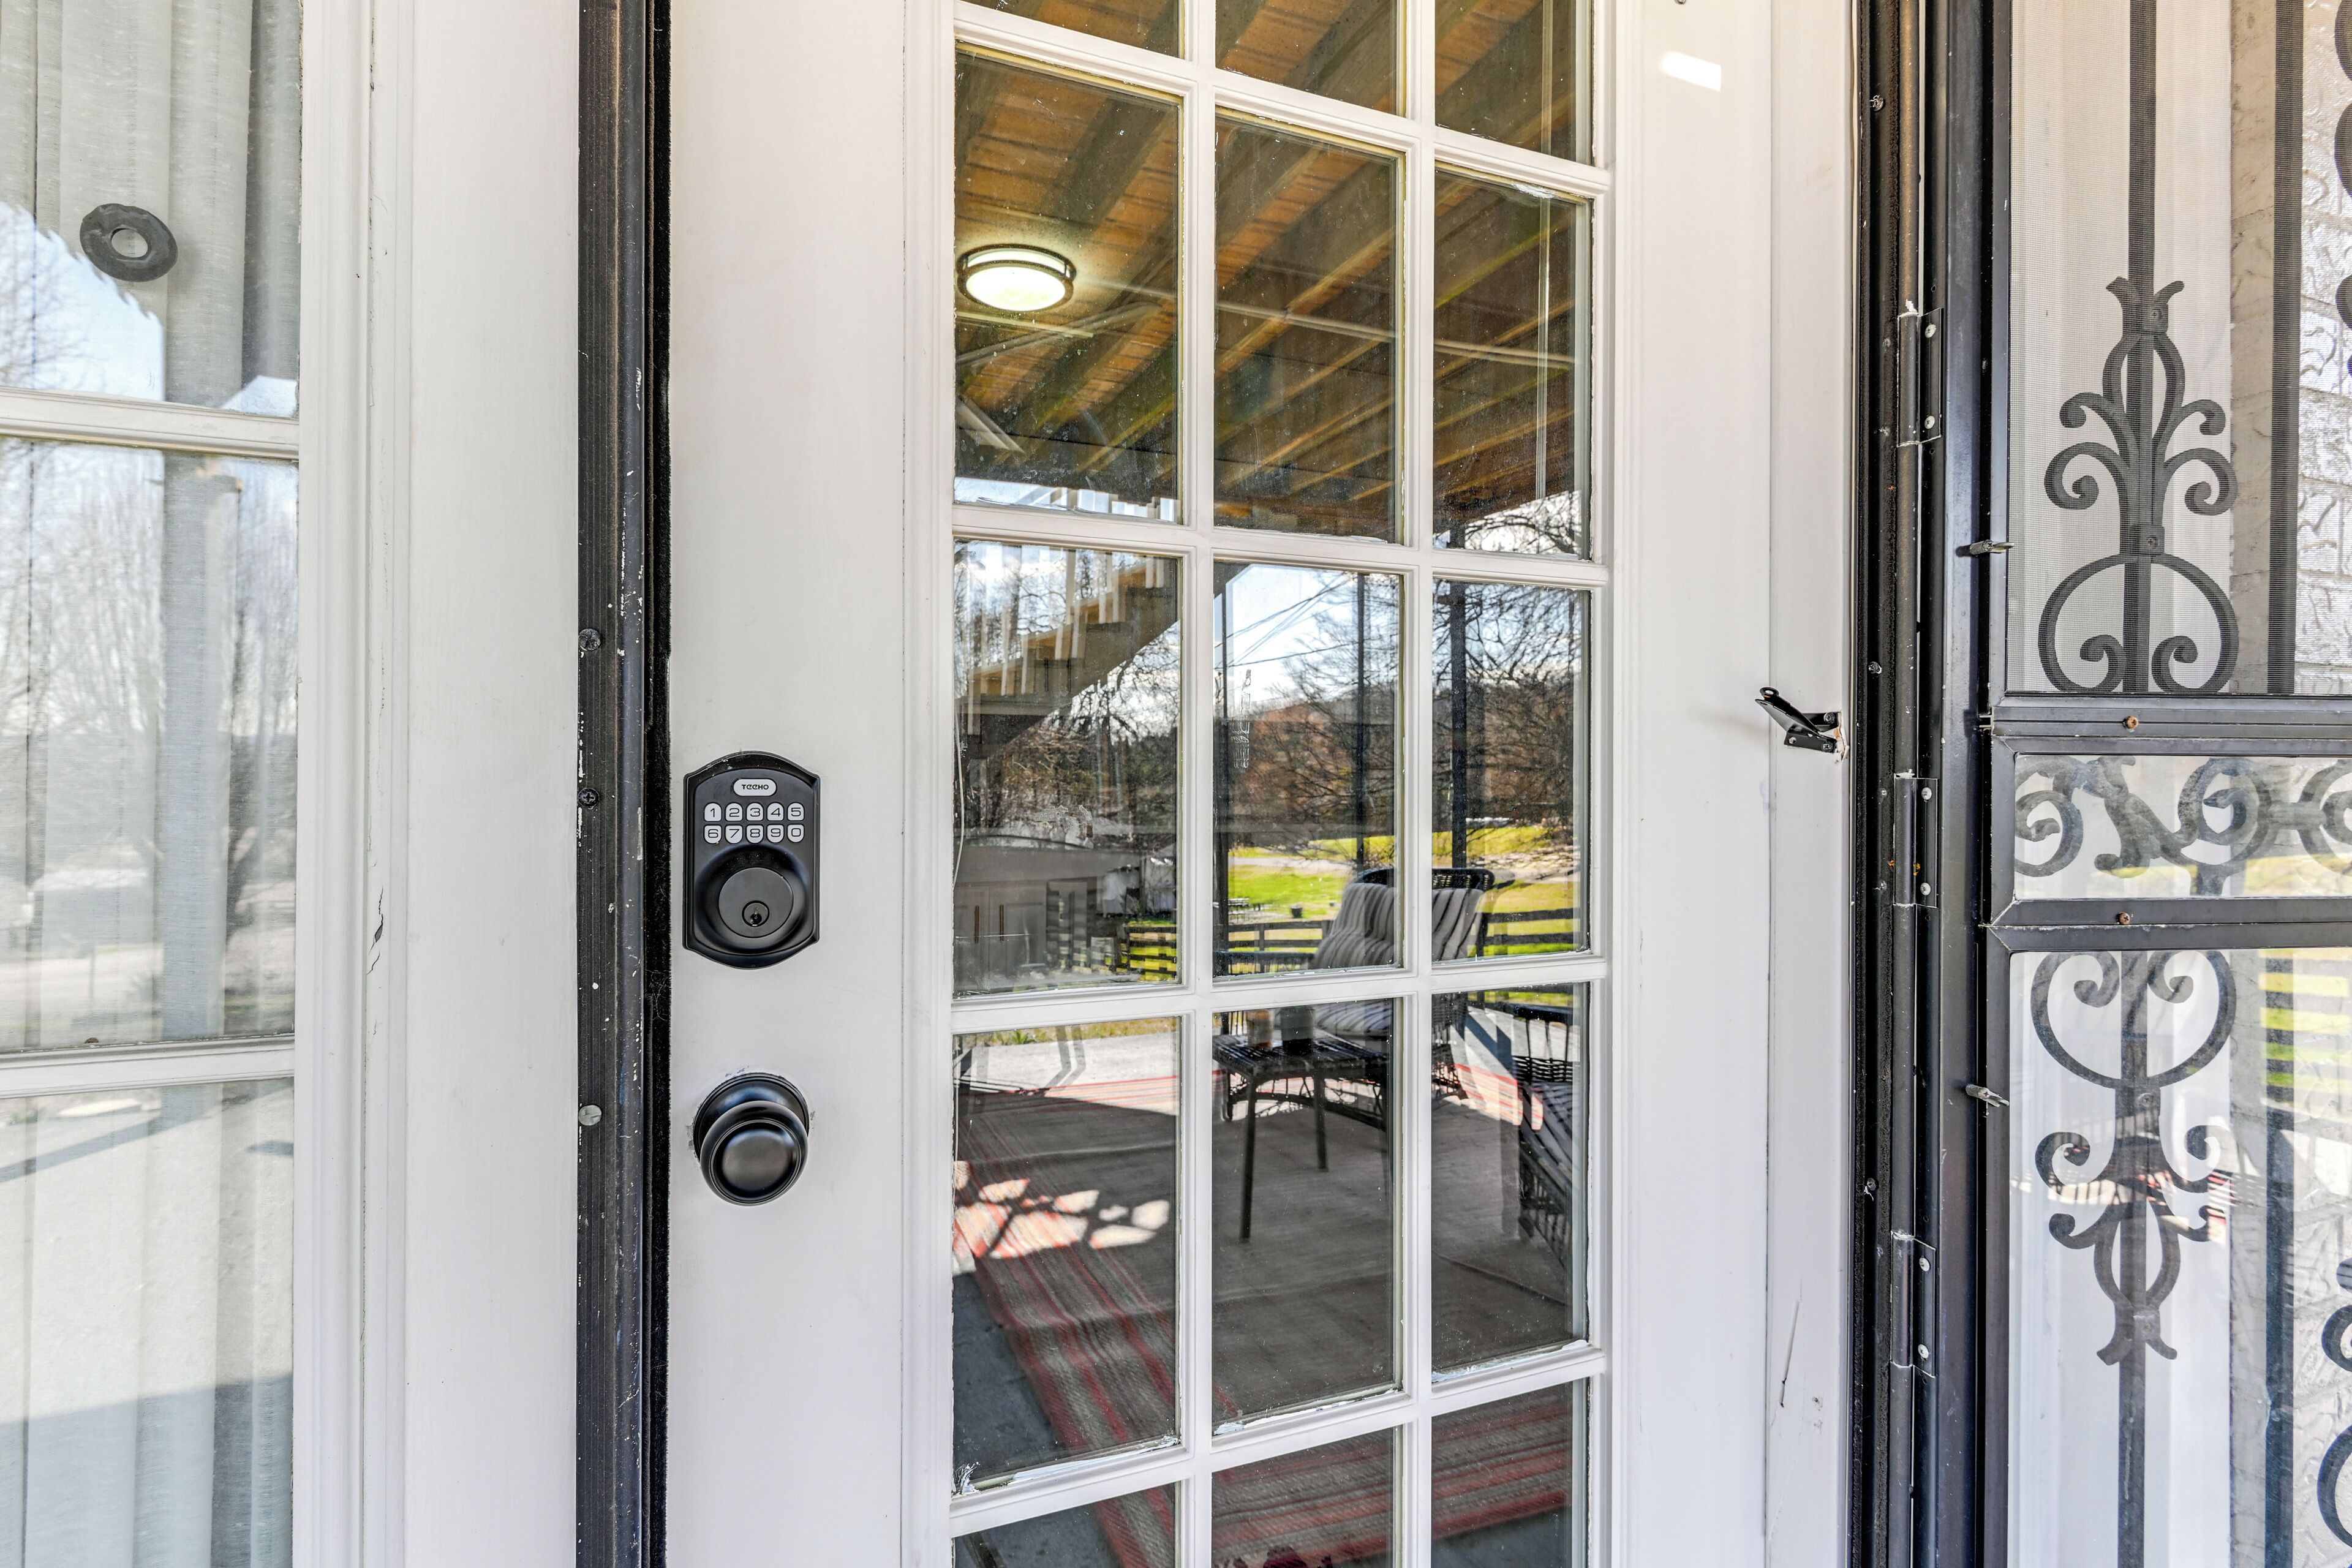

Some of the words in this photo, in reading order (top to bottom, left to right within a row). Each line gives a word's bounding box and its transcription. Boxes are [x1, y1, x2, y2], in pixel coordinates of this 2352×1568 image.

[710, 808, 715, 818] 1
[729, 807, 740, 817] 2
[750, 807, 761, 817] 3
[771, 807, 781, 817] 4
[791, 807, 801, 817] 5
[708, 829, 718, 838] 6
[729, 829, 740, 838] 7
[750, 828, 760, 838] 8
[771, 828, 781, 837] 9
[791, 827, 801, 837] 0
